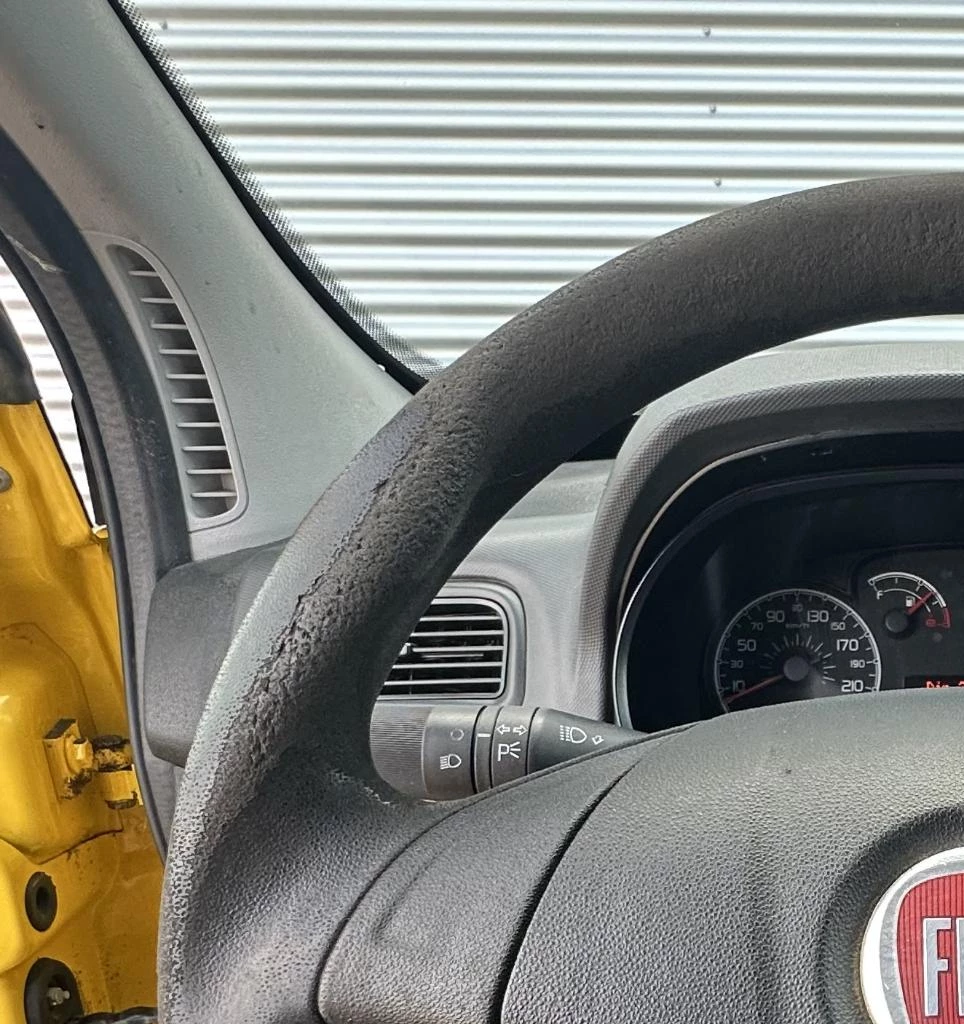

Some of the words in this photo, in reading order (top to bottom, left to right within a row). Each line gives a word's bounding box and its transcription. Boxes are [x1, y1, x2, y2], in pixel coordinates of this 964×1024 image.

[766, 610, 785, 623] 90
[807, 610, 829, 623] 130
[751, 622, 764, 631] 70
[830, 622, 846, 631] 150
[737, 640, 757, 651] 50
[836, 639, 859, 651] 170
[731, 660, 743, 668] 30
[850, 660, 865, 668] 190
[732, 681, 745, 692] 10
[841, 680, 864, 693] 210
